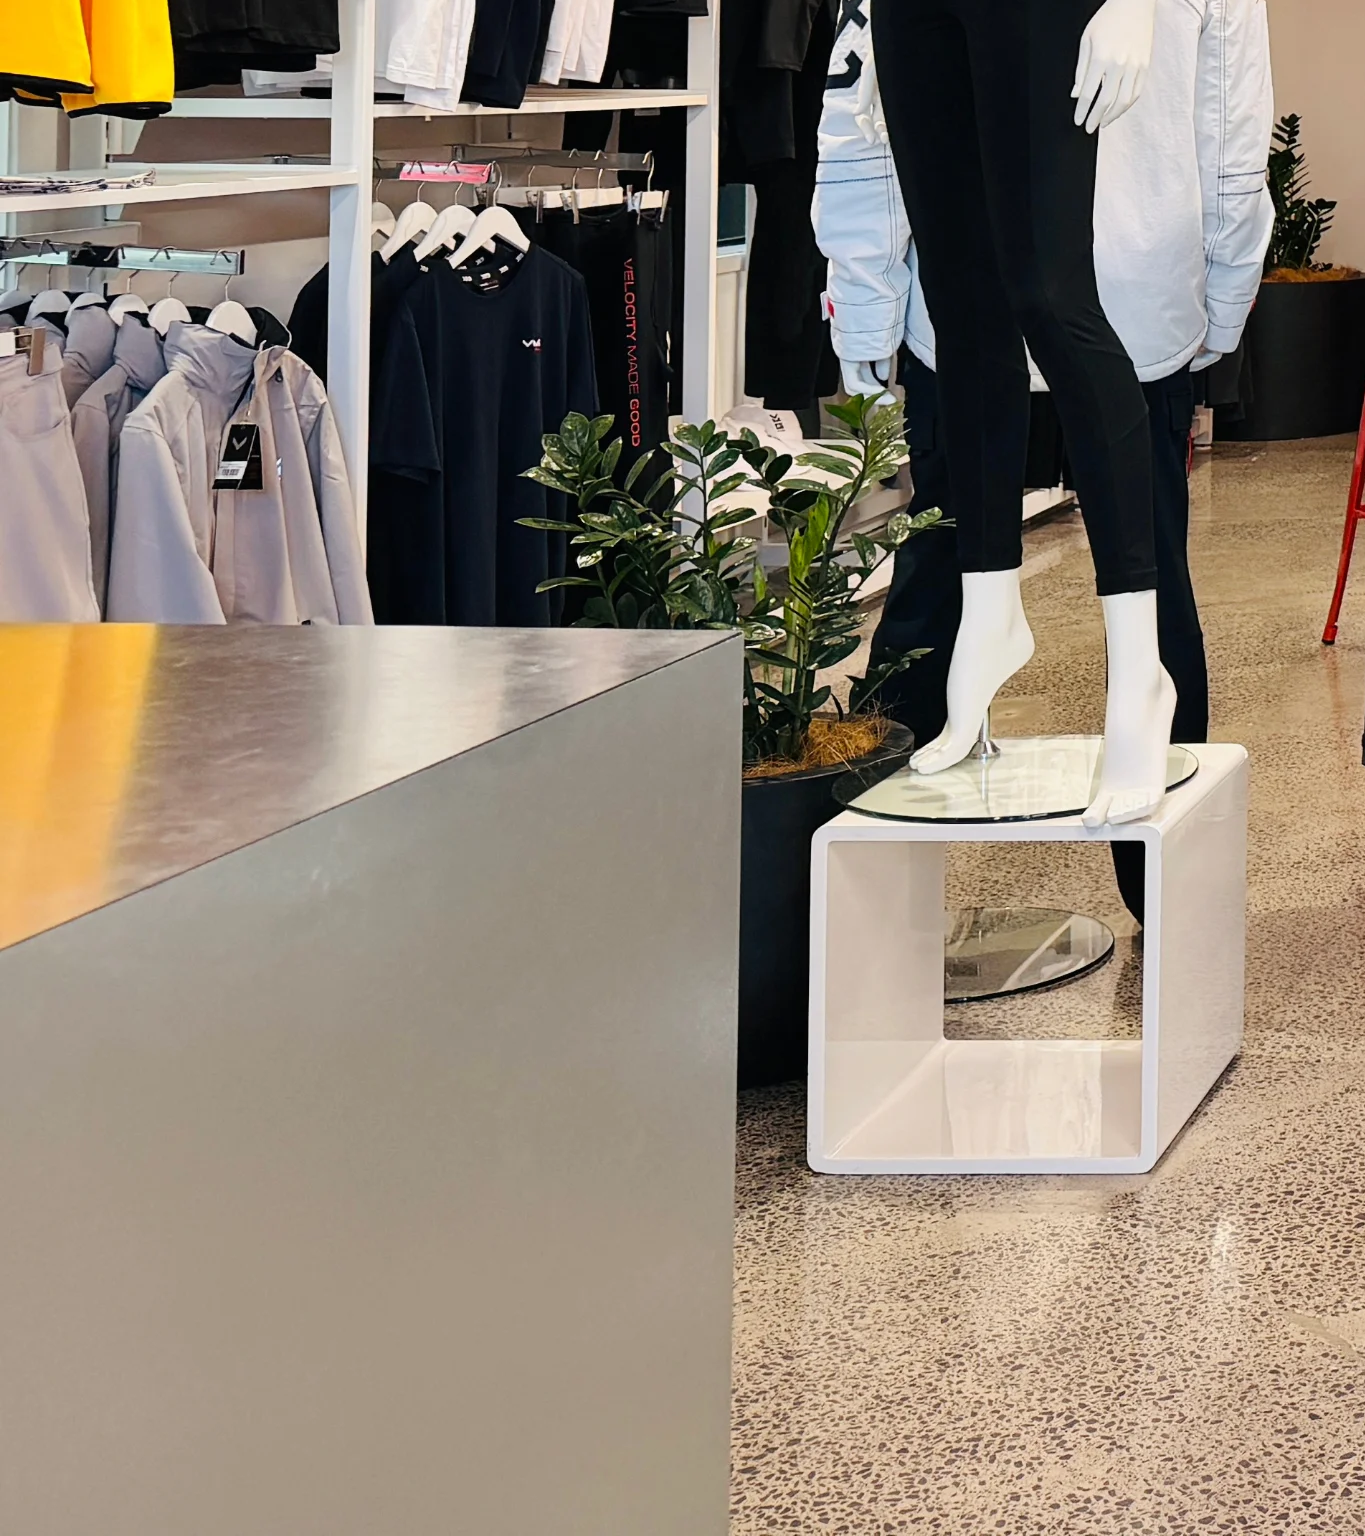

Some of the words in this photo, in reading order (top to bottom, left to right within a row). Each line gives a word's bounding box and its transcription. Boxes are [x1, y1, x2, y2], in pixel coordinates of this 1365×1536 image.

[624, 258, 637, 341] VELOCITY
[627, 345, 640, 395] MADE
[629, 398, 641, 448] GOOD
